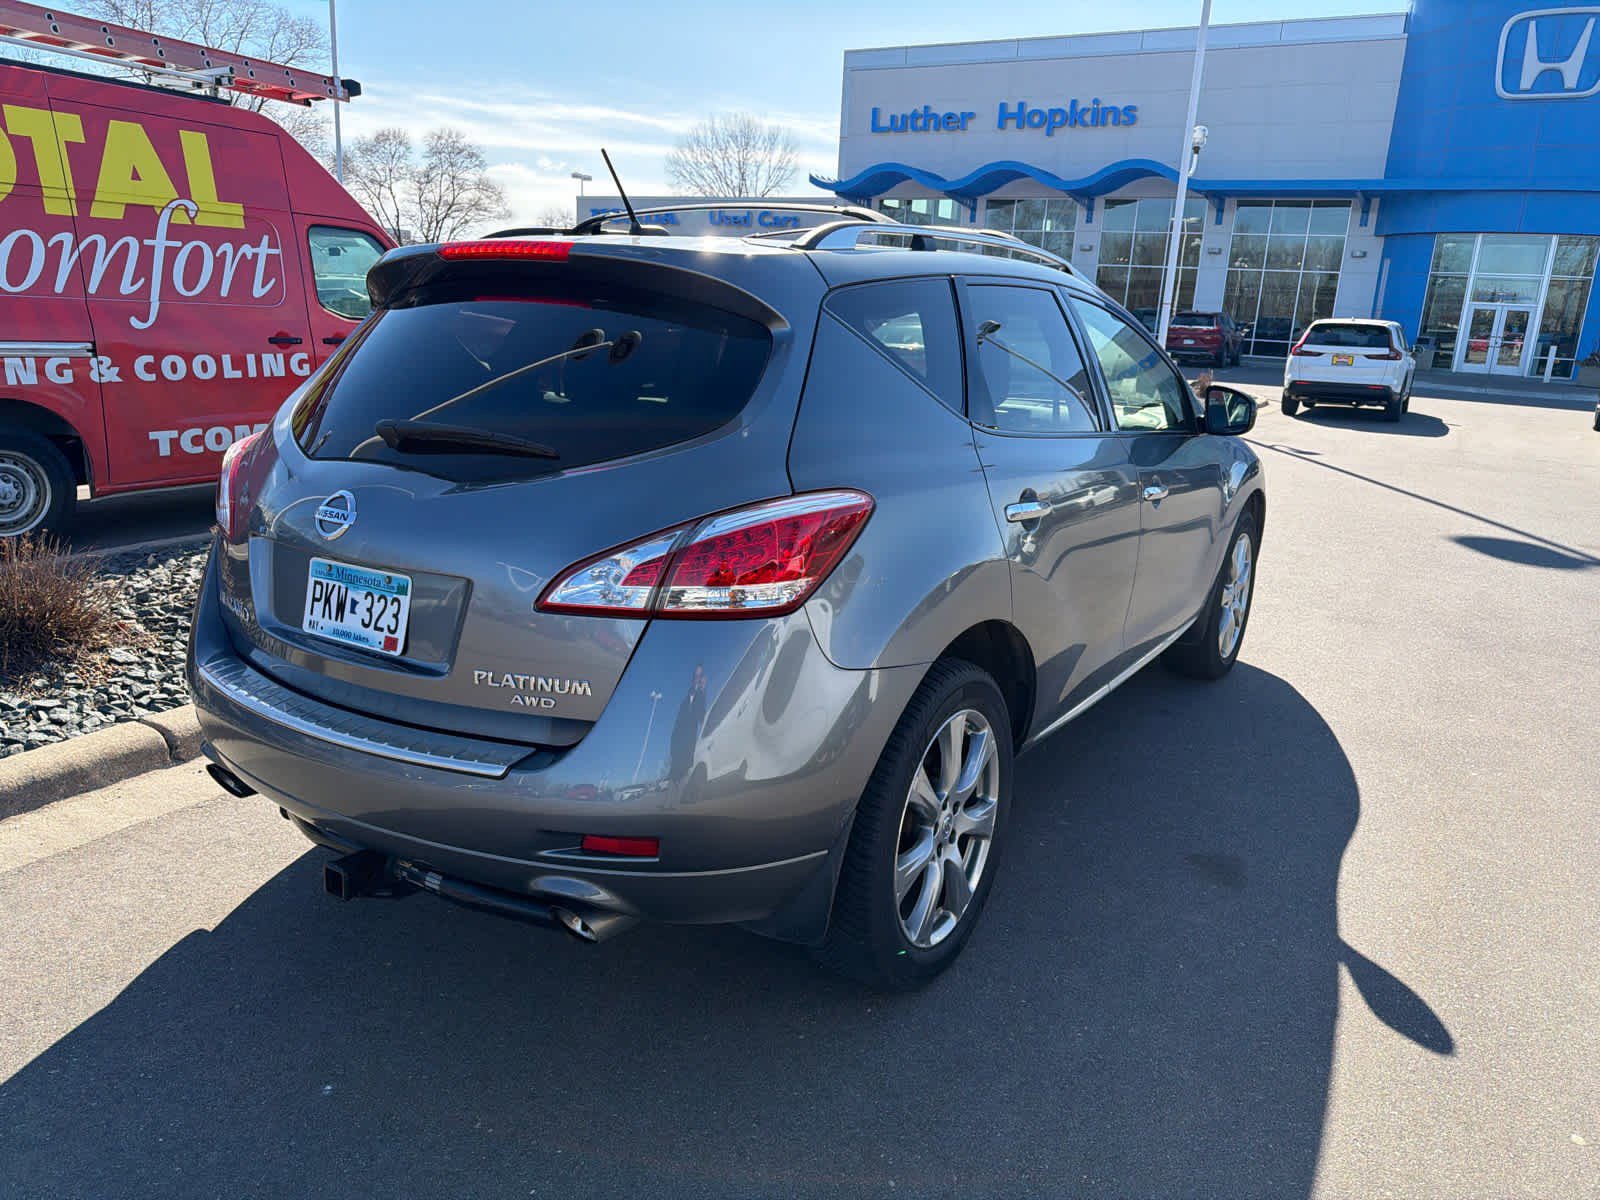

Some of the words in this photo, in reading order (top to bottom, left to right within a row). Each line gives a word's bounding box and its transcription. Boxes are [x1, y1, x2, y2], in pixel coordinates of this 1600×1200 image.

[870, 105, 976, 134] Luther
[997, 97, 1139, 136] Hopkins
[709, 209, 753, 227] Used
[757, 210, 800, 228] Cars
[88, 355, 124, 383] &
[133, 352, 312, 382] COOLING
[317, 510, 349, 522] NISSAN
[335, 567, 382, 587] Minnesota
[310, 579, 349, 623] PKW
[361, 591, 402, 635] 323
[473, 670, 592, 697] PLATINUM
[510, 694, 557, 708] AWD
